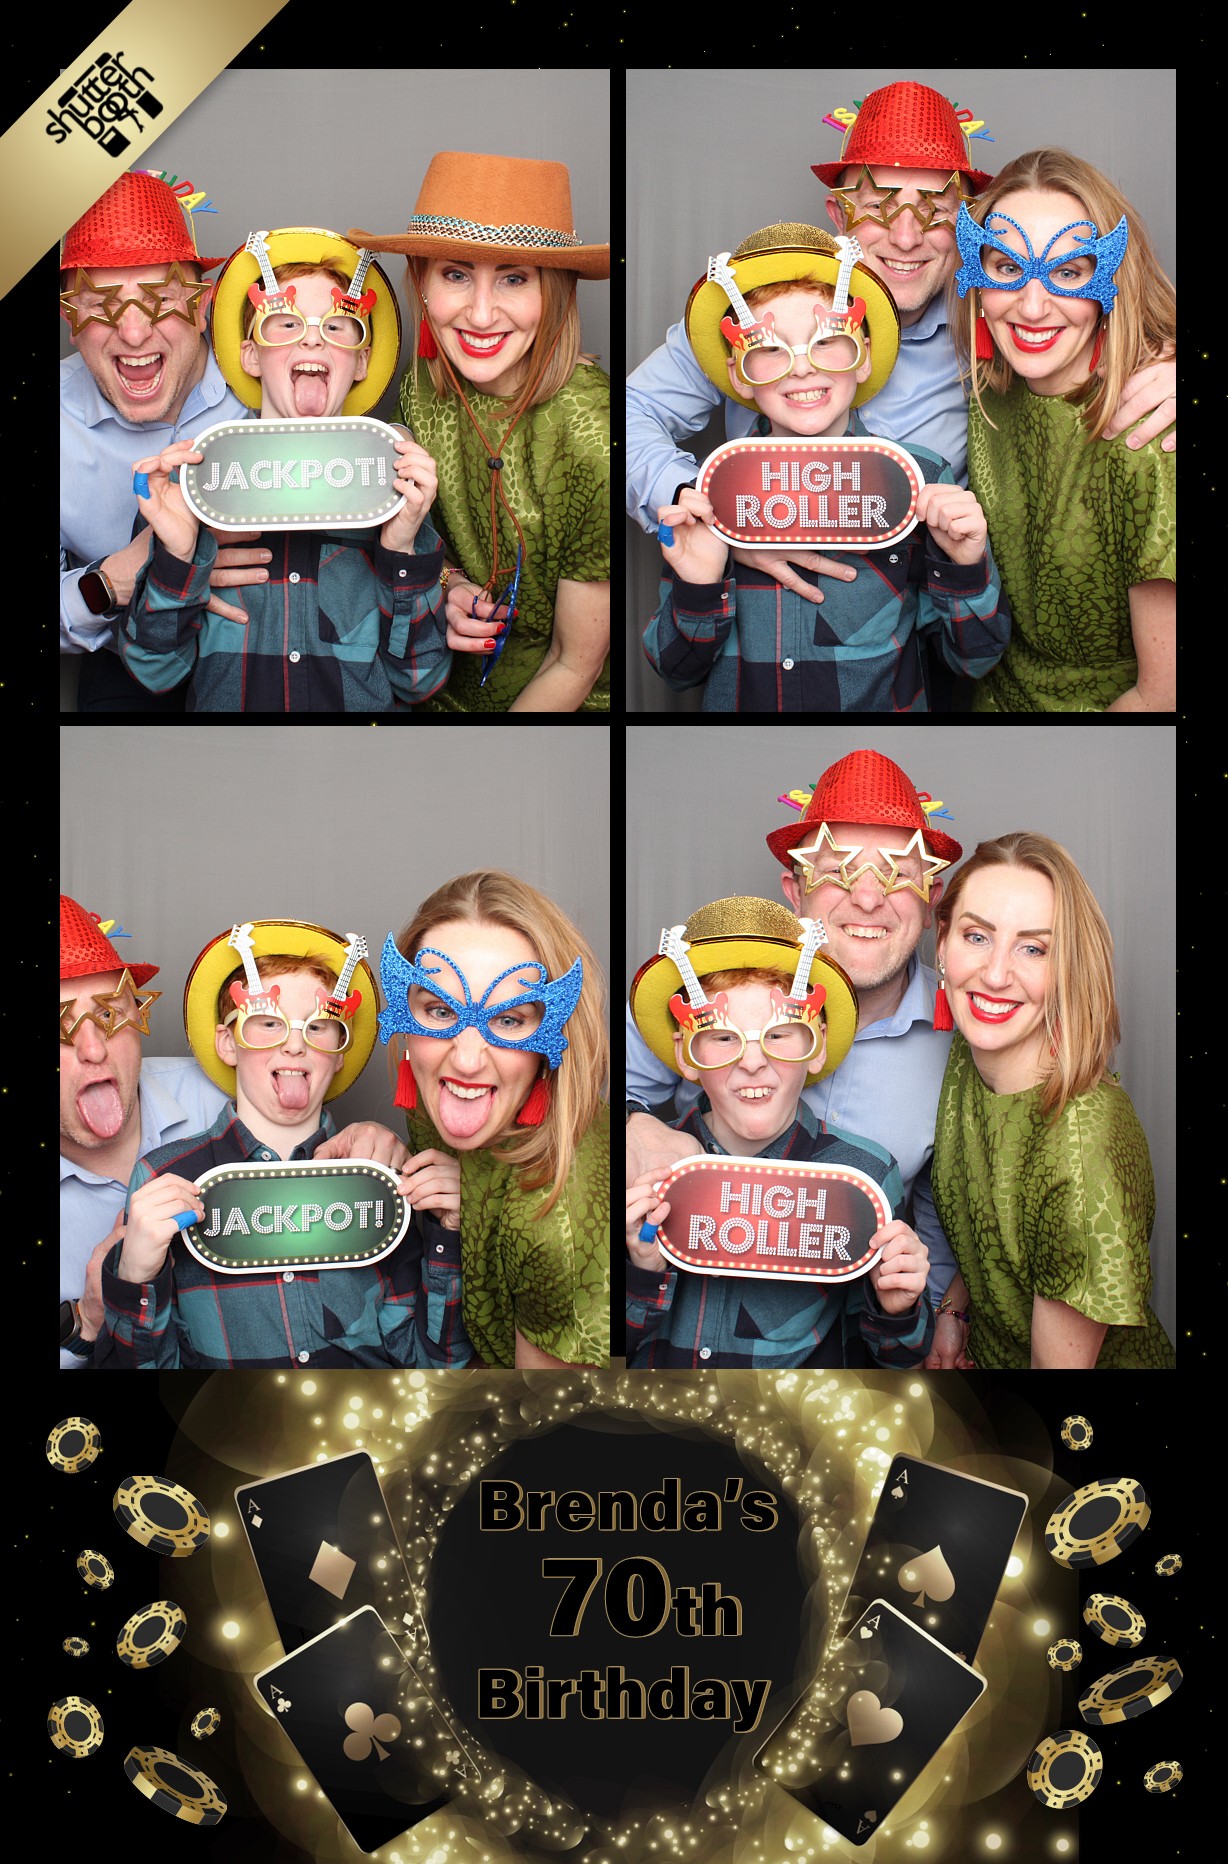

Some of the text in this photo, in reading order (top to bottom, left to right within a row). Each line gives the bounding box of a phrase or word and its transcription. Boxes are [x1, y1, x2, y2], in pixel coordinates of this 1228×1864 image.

[202, 456, 387, 492] JACKPOT!
[761, 461, 861, 493] HIGH
[735, 494, 890, 529] ROLLER
[203, 1199, 384, 1237] JACKPOT!
[719, 1181, 827, 1220] HIGH
[688, 1214, 852, 1261] ROLLER
